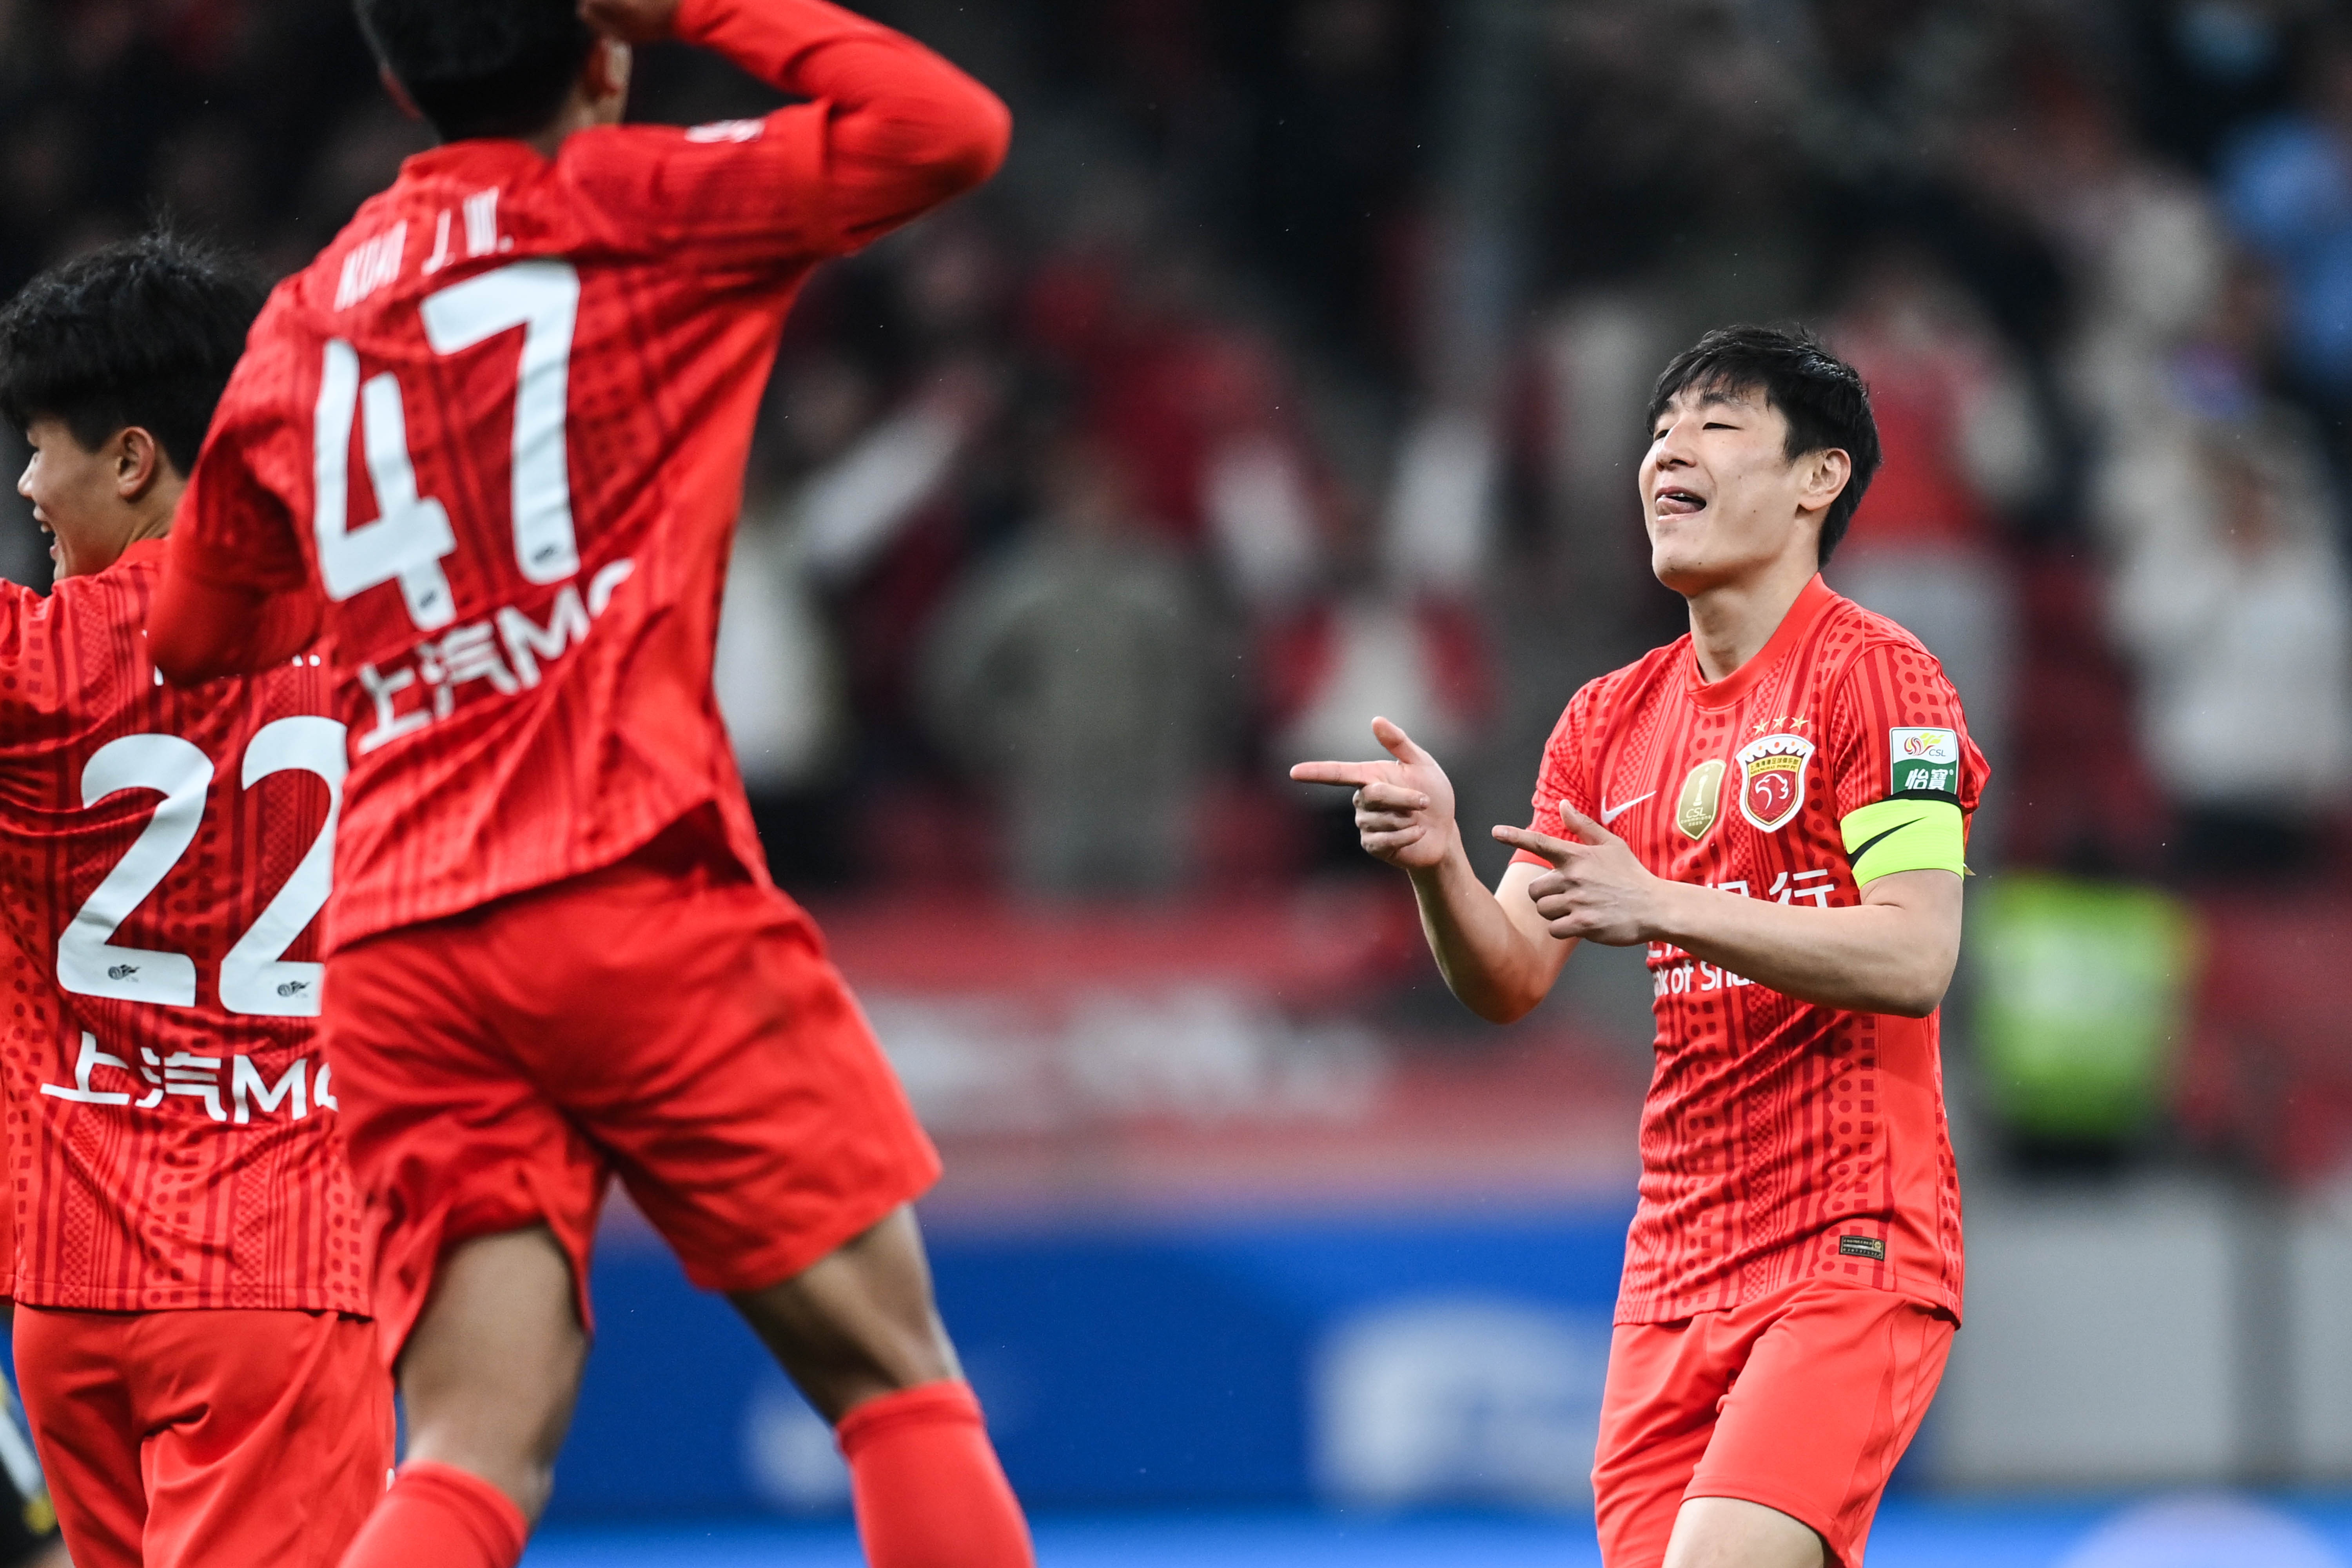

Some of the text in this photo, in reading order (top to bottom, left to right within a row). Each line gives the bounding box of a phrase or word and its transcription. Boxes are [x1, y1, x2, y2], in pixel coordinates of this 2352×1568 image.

[312, 259, 581, 632] 47
[1686, 807, 1706, 818] CSL
[1905, 768, 1948, 791] 怡寶
[56, 715, 348, 1018] 22
